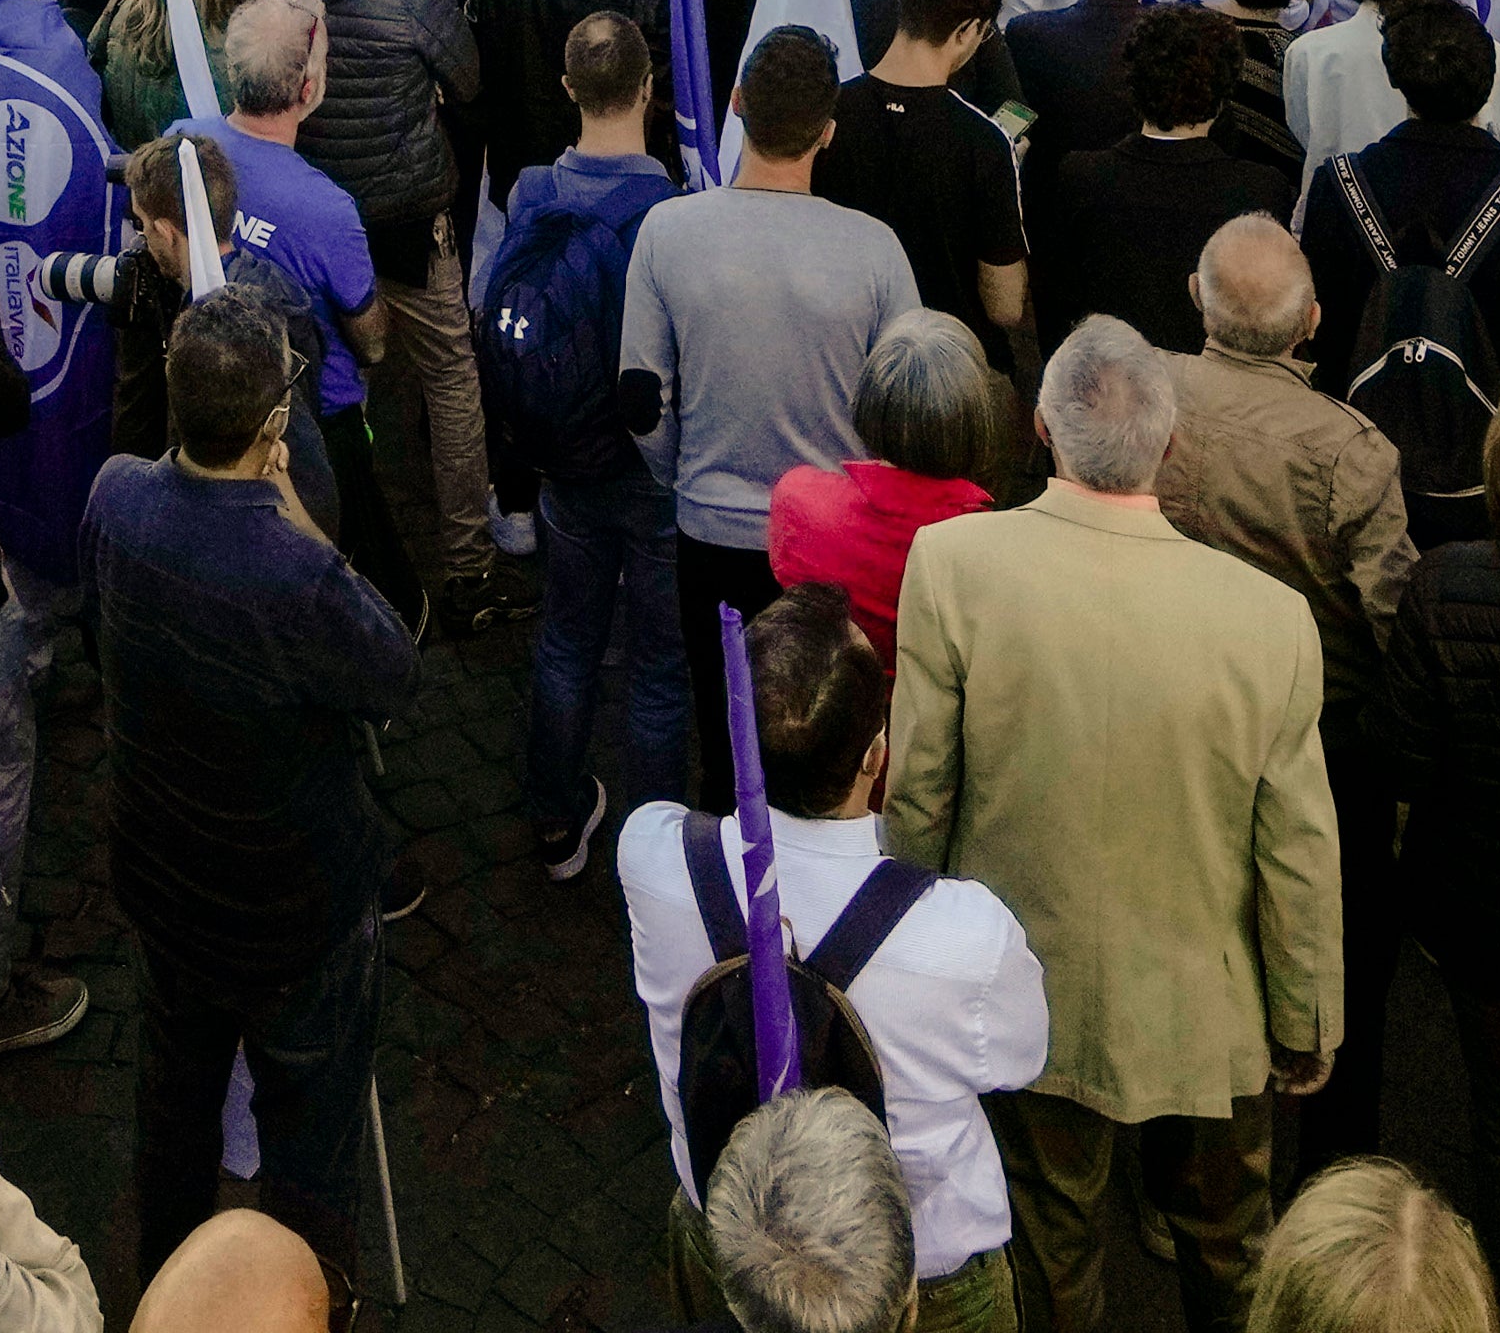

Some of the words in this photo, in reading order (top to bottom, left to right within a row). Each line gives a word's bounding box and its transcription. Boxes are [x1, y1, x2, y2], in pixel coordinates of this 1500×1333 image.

[5, 103, 30, 223] AZIONE
[1347, 183, 1367, 214] TOMMY
[1453, 232, 1479, 265] TOMMY
[1475, 206, 1498, 234] JEANS
